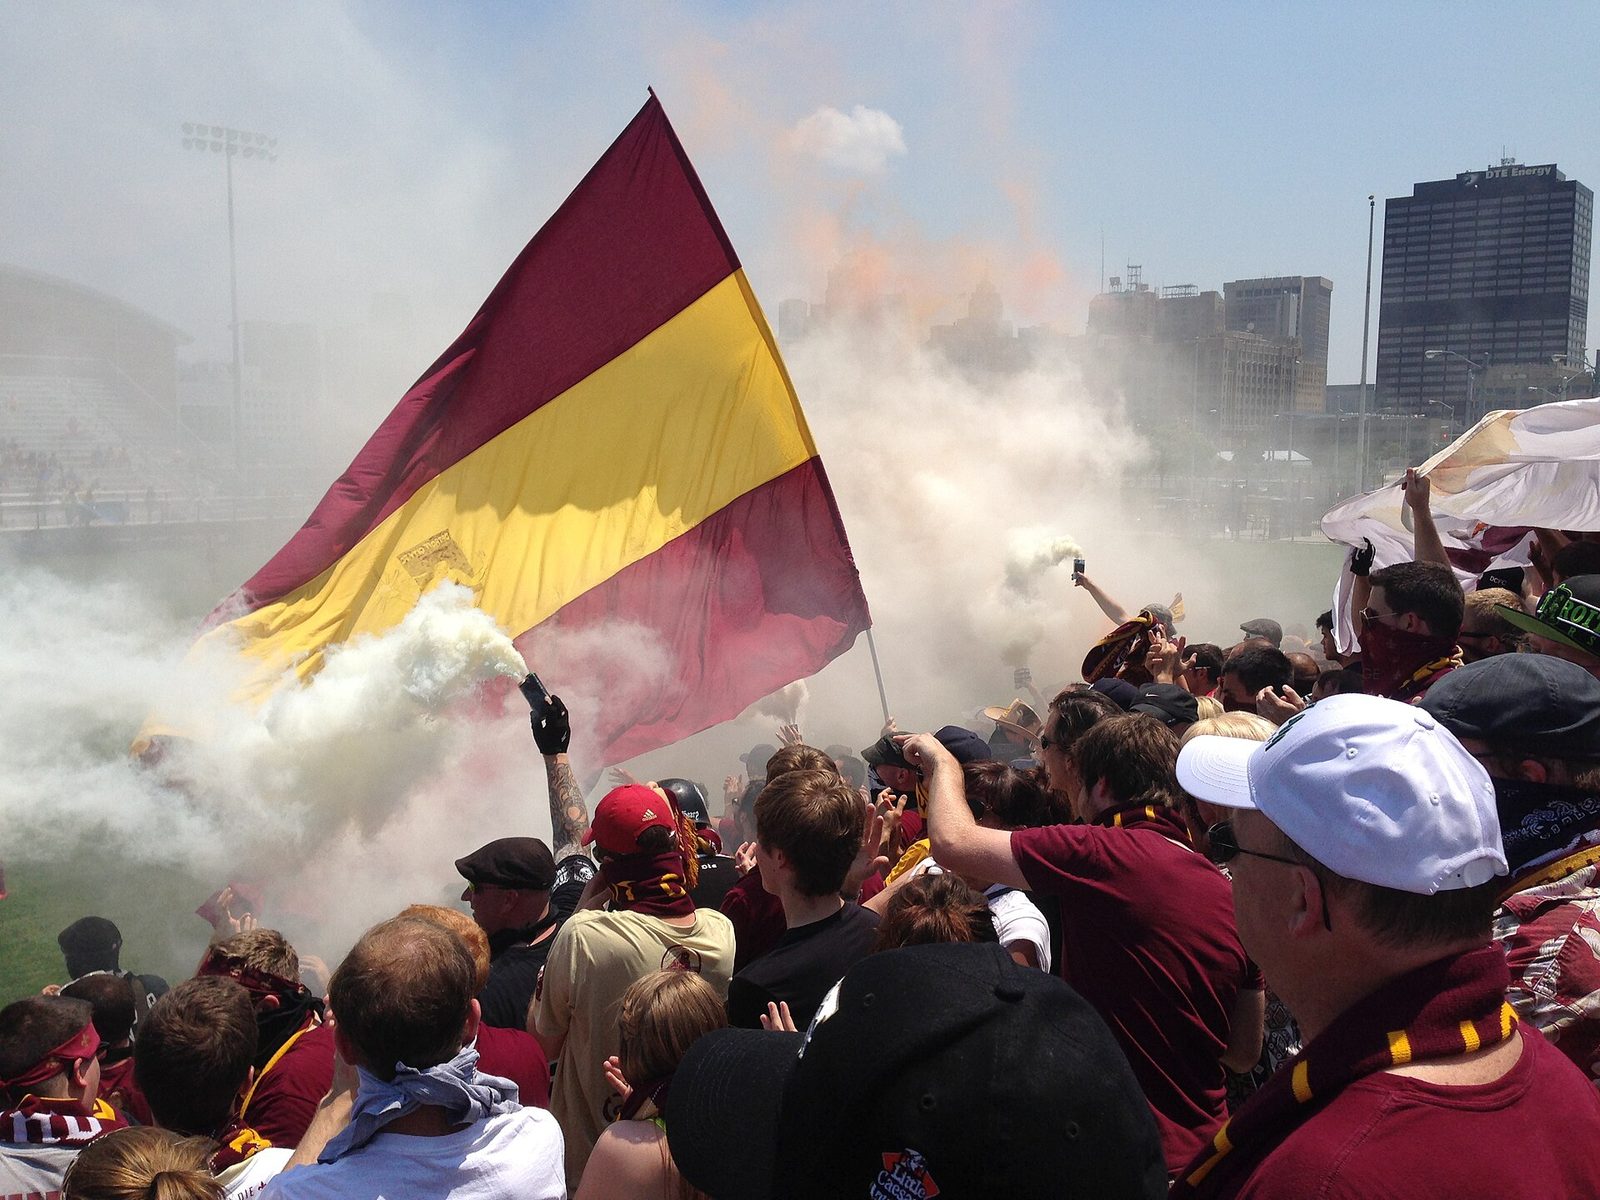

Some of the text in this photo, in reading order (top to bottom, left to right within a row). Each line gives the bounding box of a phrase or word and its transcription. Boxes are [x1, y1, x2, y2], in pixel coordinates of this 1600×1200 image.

[1485, 166, 1552, 179] DTE Energy
[891, 1163, 927, 1199] Little
